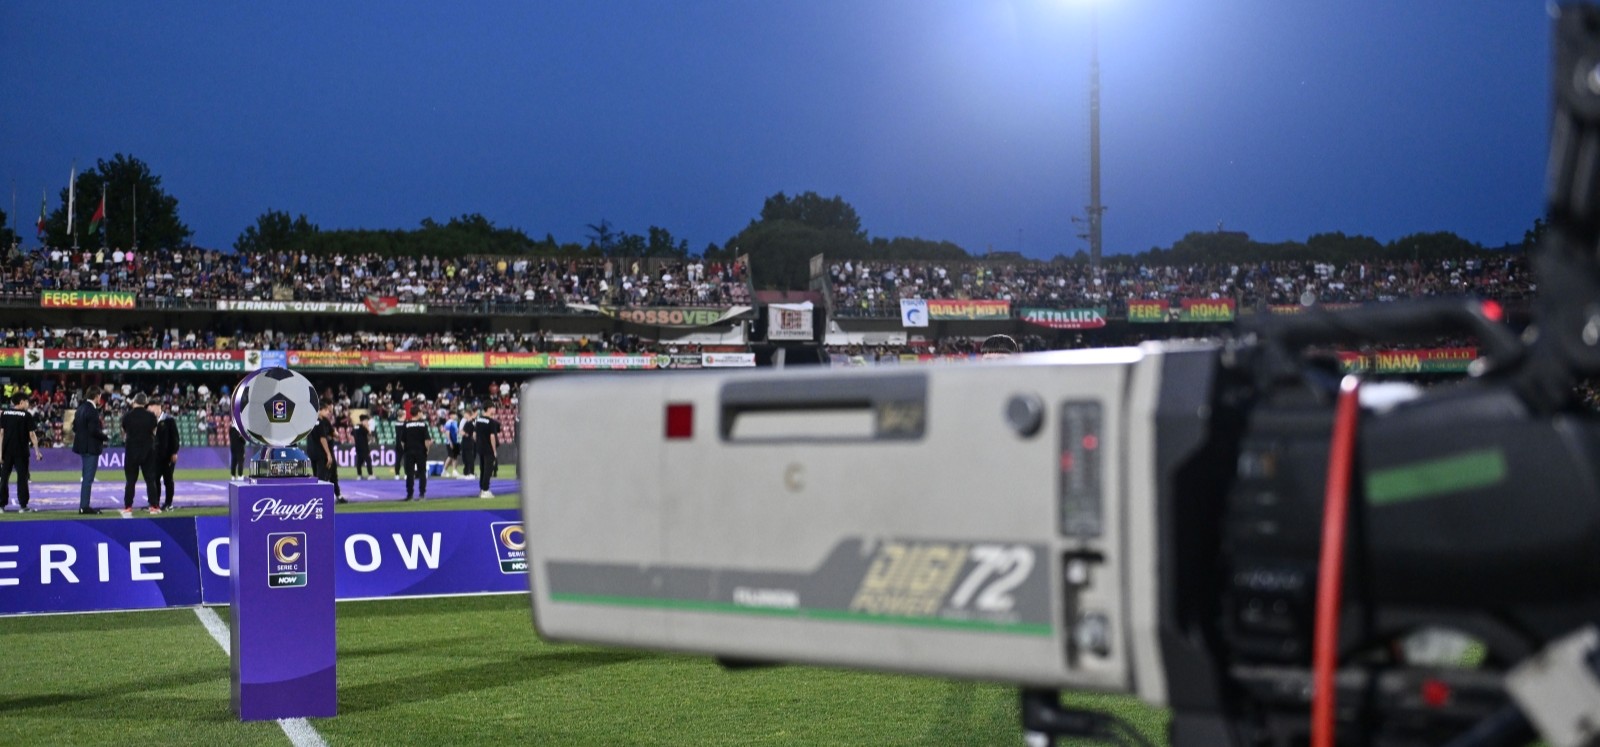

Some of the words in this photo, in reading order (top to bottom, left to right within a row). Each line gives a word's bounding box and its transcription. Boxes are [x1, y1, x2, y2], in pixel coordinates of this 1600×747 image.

[44, 292, 78, 305] FERE
[83, 292, 134, 306] LATINA
[619, 309, 720, 325] ROSSOVER
[1025, 310, 1106, 326] METALLICA
[1129, 304, 1161, 318] FERE
[1190, 304, 1230, 318] ROMA
[58, 350, 109, 360] centro
[113, 349, 232, 360] coordinamento
[48, 360, 198, 370] TERNANA
[202, 360, 241, 371] clubs
[250, 497, 323, 522] Playoff
[344, 532, 441, 572] OW
[278, 576, 297, 584] NOW
[950, 545, 1036, 611] 72
